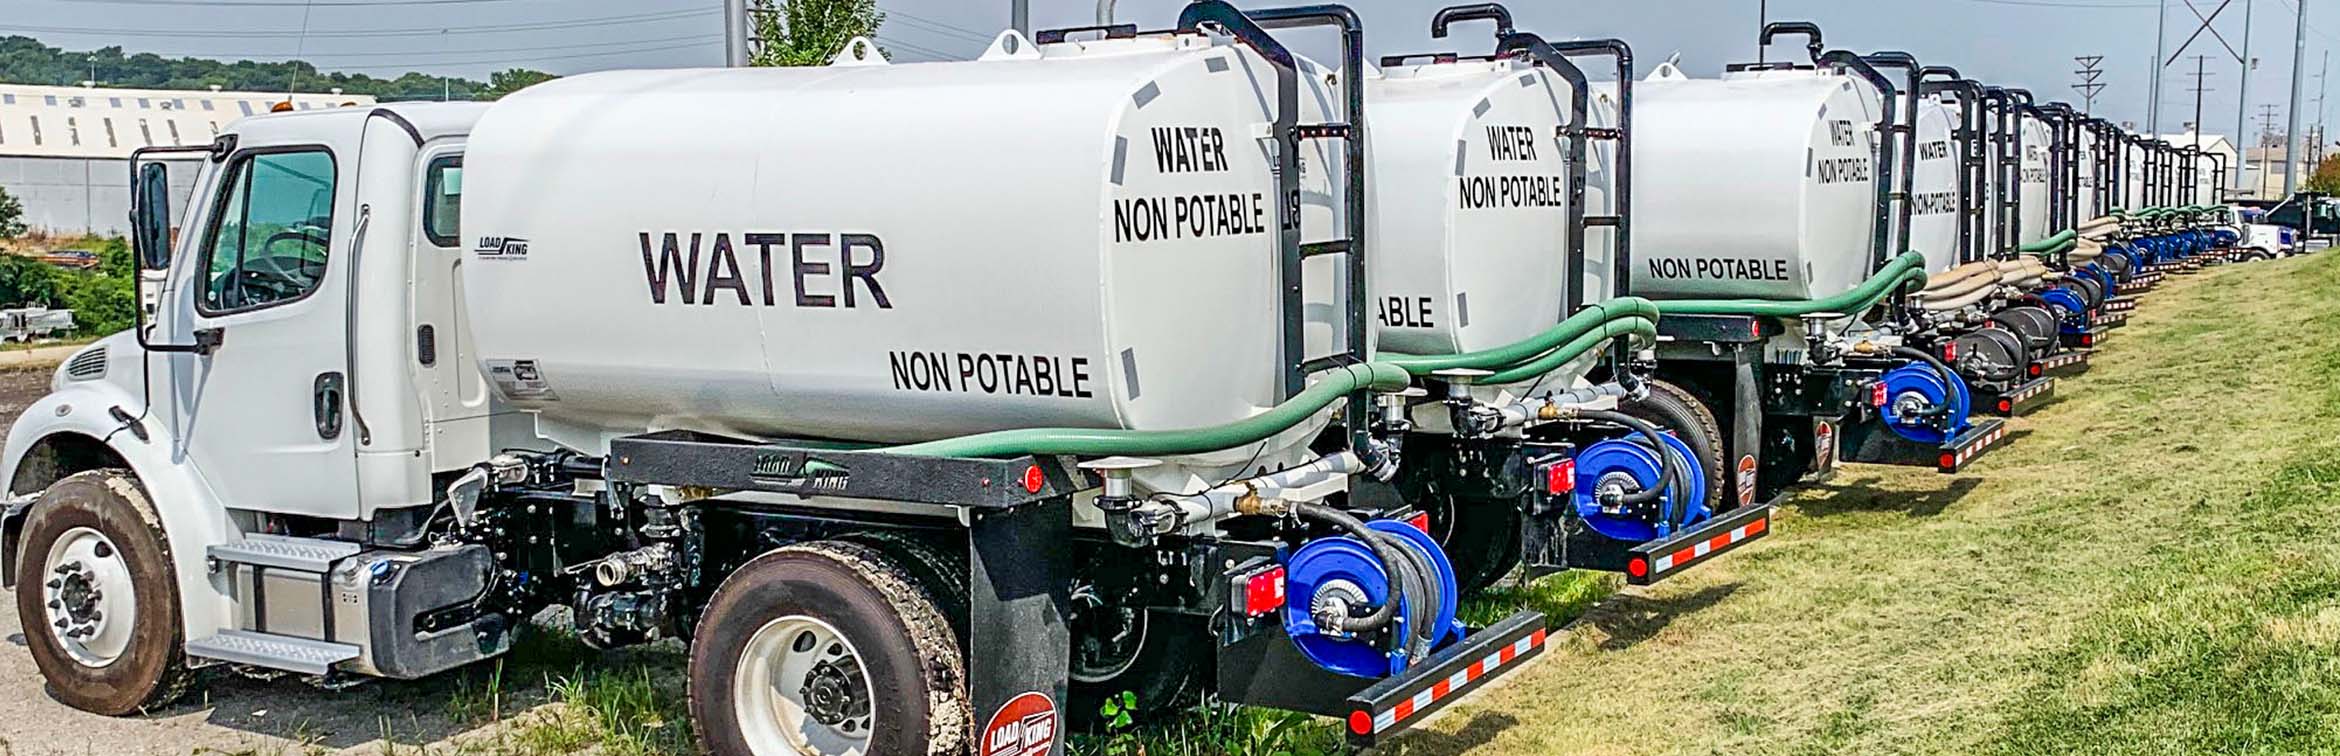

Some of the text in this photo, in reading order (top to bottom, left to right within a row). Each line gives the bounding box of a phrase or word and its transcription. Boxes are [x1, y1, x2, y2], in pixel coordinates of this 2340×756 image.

[1486, 126, 1537, 160] WATER
[1828, 120, 1855, 146] WATER
[1151, 127, 1228, 173] WATER
[1919, 141, 1948, 160] WATER
[1818, 158, 1868, 184] NON POTABLE
[1460, 176, 1561, 209] NON POTABLE
[1114, 198, 1168, 243] NON
[1174, 193, 1265, 239] POTABLE
[480, 236, 528, 255] LOAD KING
[639, 232, 893, 309] WATER
[1649, 258, 1788, 280] NON POTABLE
[889, 351, 1093, 398] NON POTABLE
[990, 718, 1052, 752] LOAD KING
